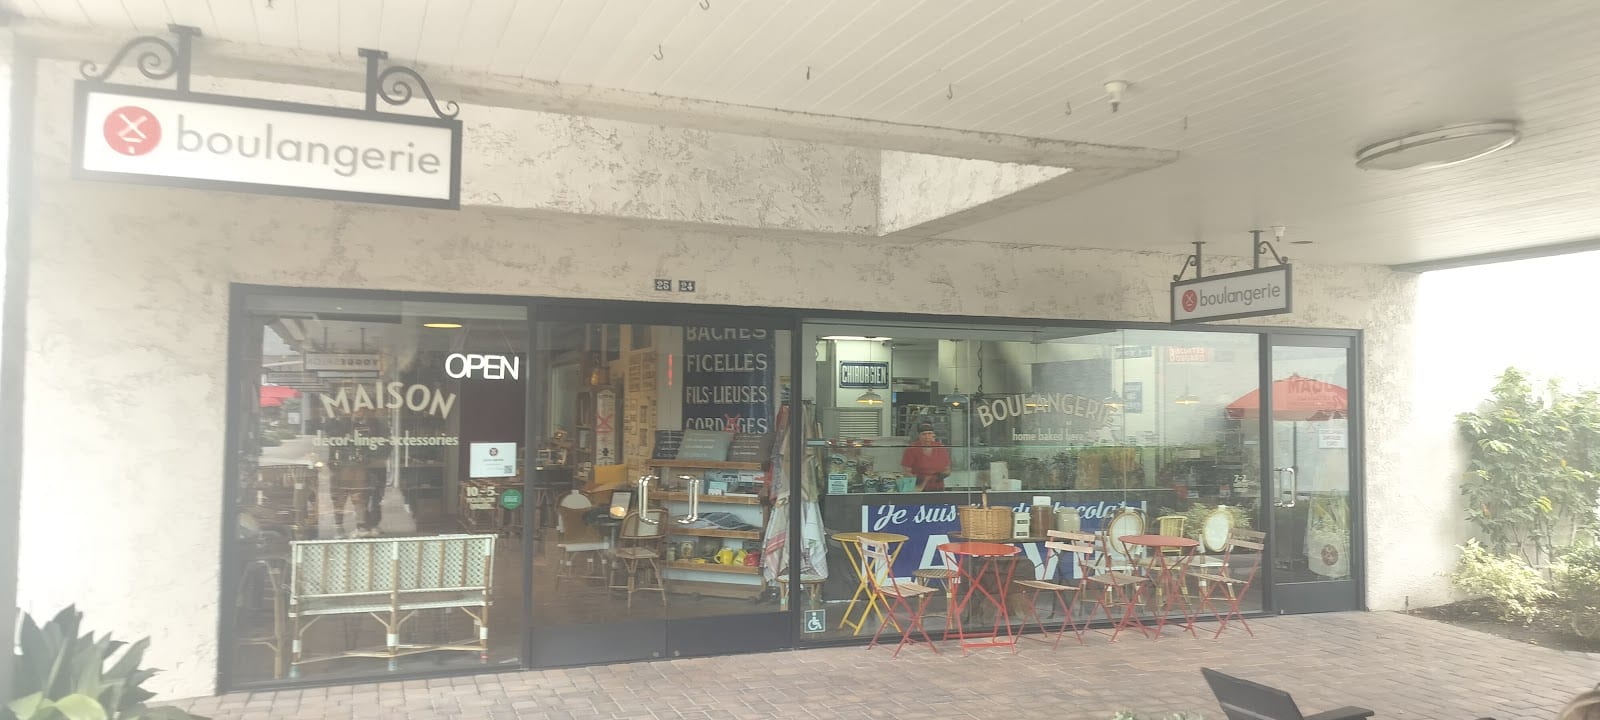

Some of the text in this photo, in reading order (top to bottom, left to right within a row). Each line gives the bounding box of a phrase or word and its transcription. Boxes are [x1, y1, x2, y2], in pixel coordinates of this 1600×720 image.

[176, 113, 442, 178] boulangerie
[1199, 283, 1281, 307] boulangerie
[445, 352, 520, 381] OPEN
[686, 352, 768, 373] FICELLES
[319, 381, 457, 420] MAISON
[976, 391, 1120, 429] BOULANGERIE
[1012, 427, 1036, 441] home
[1038, 427, 1063, 441] baked
[873, 504, 908, 531] Je
[912, 503, 957, 524] suis
